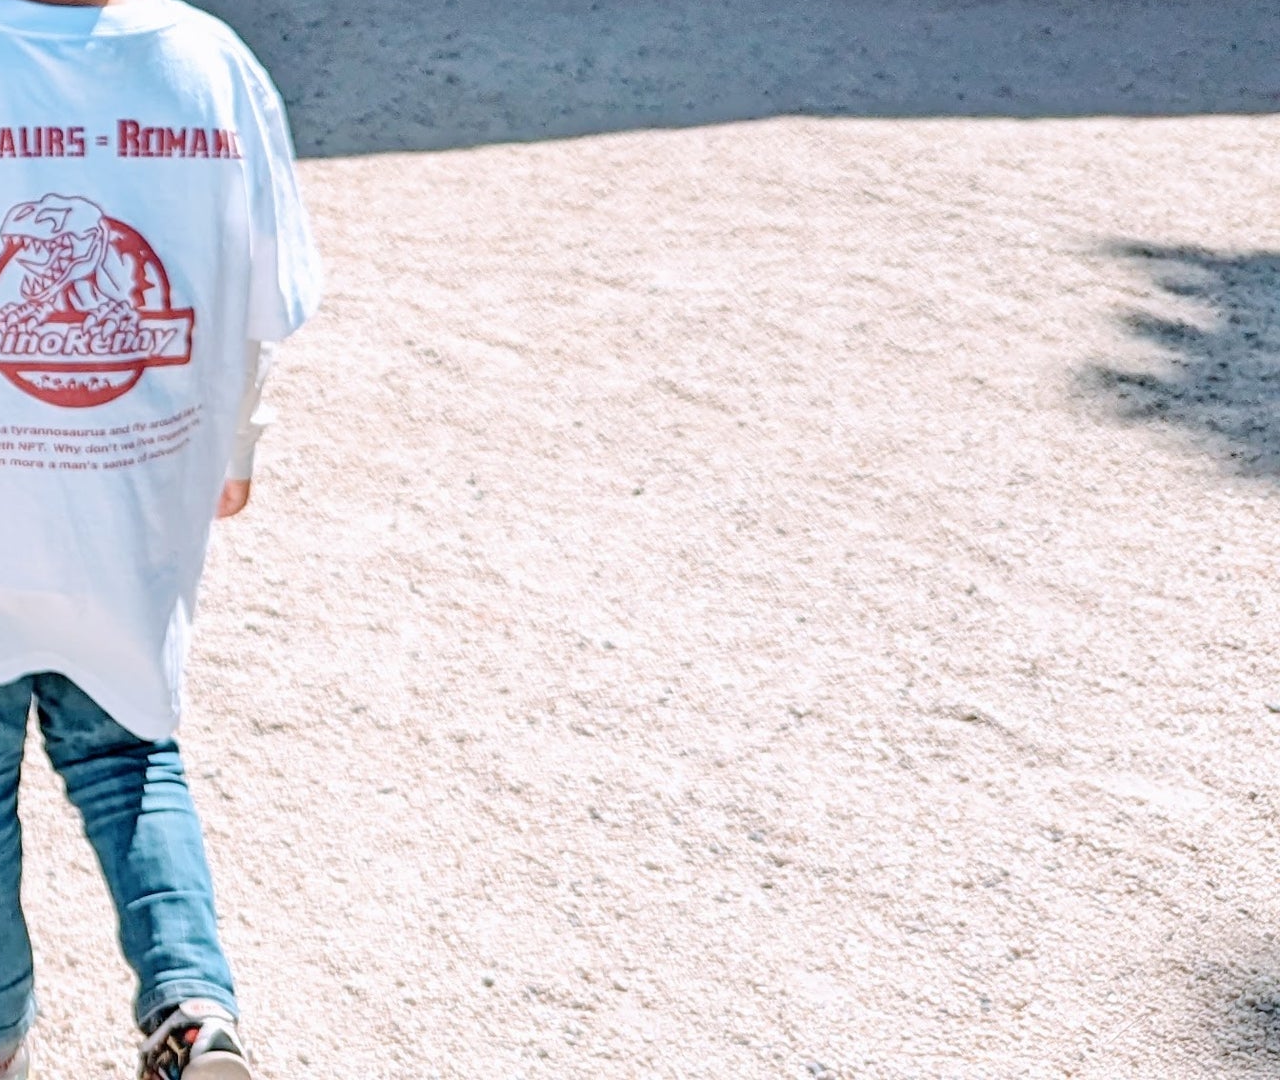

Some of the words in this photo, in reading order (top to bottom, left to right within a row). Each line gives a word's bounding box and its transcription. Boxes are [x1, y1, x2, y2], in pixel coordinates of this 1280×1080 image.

[11, 425, 106, 438] tyrannosaurus
[109, 424, 130, 436] and
[53, 442, 81, 455] Why
[9, 457, 45, 469] more
[59, 460, 99, 470] man's
